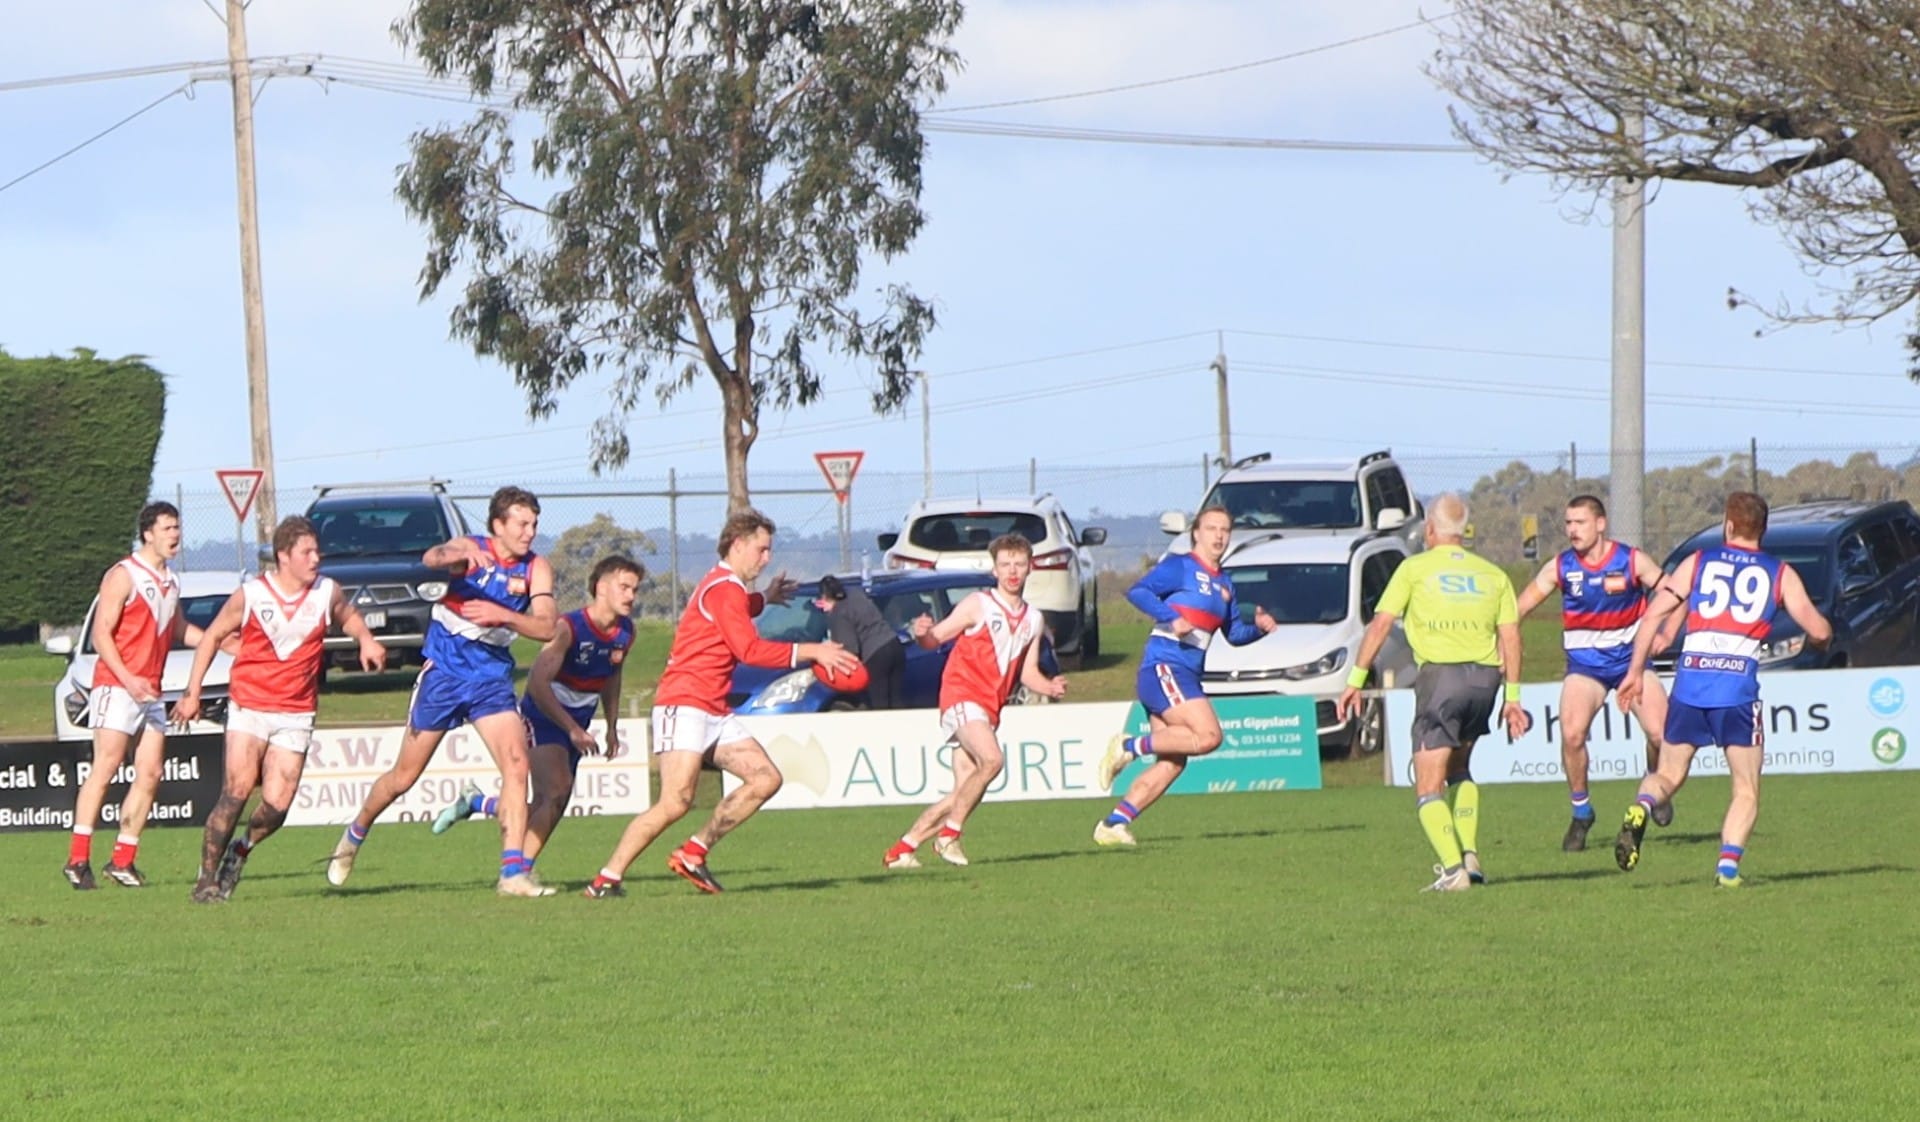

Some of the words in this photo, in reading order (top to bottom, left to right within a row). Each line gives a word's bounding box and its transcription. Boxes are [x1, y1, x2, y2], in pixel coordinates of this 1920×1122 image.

[1438, 574, 1486, 594] SL
[1697, 560, 1771, 624] 59
[1243, 714, 1300, 731] Gippsland
[48, 762, 67, 787] &
[842, 738, 1086, 798] AUSURE
[0, 807, 73, 829] Building
